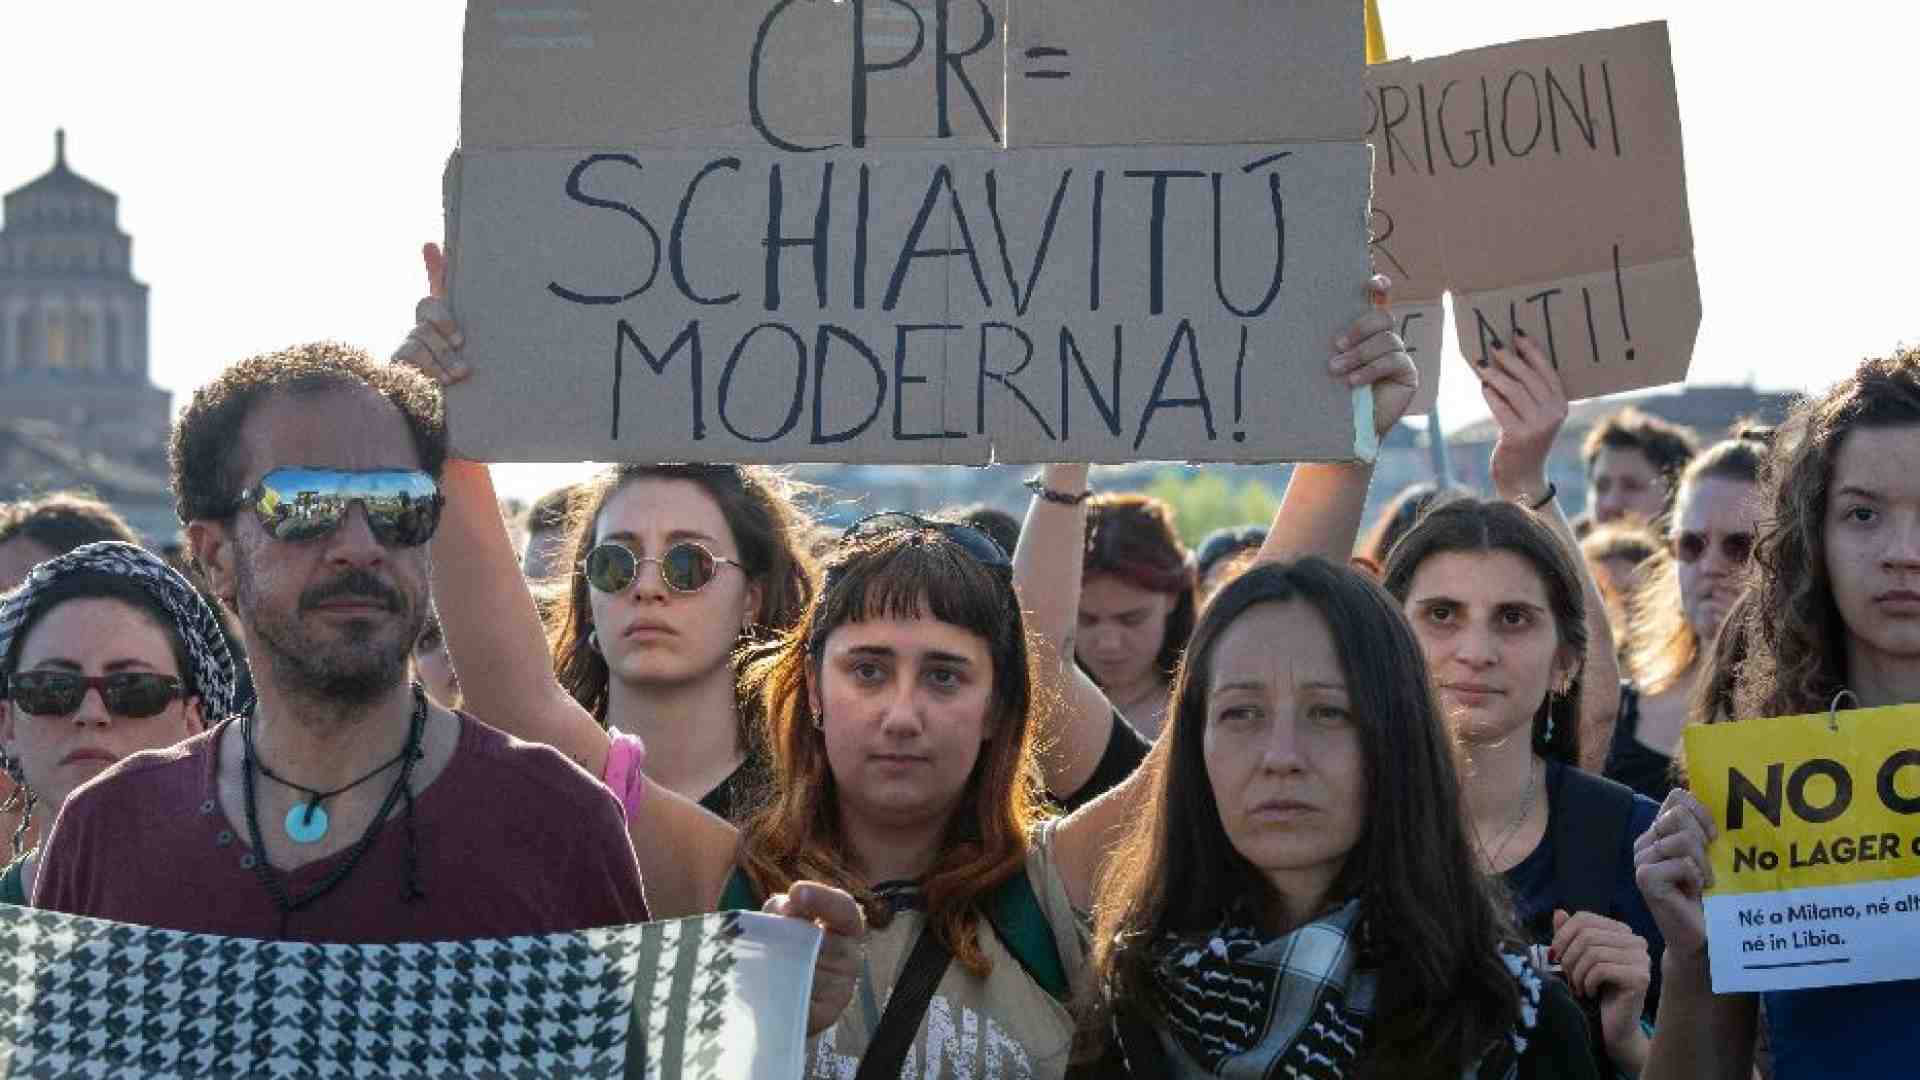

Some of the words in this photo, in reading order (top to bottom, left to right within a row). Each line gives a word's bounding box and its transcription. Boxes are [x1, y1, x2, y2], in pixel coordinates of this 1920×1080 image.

[749, 0, 999, 152] CPR
[548, 151, 1294, 318] SCHIAVITÚ
[611, 319, 1249, 451] MODERNA!
[1726, 758, 1853, 831] NO
[1733, 846, 1779, 873] No
[1790, 832, 1901, 868] LAGER
[1738, 909, 1764, 927] Né
[1770, 911, 1783, 924] a
[1788, 902, 1861, 923] Milano,
[1866, 897, 1890, 915] né
[1742, 936, 1765, 953] né
[1770, 933, 1787, 951] in
[1792, 929, 1846, 949] Libia.
